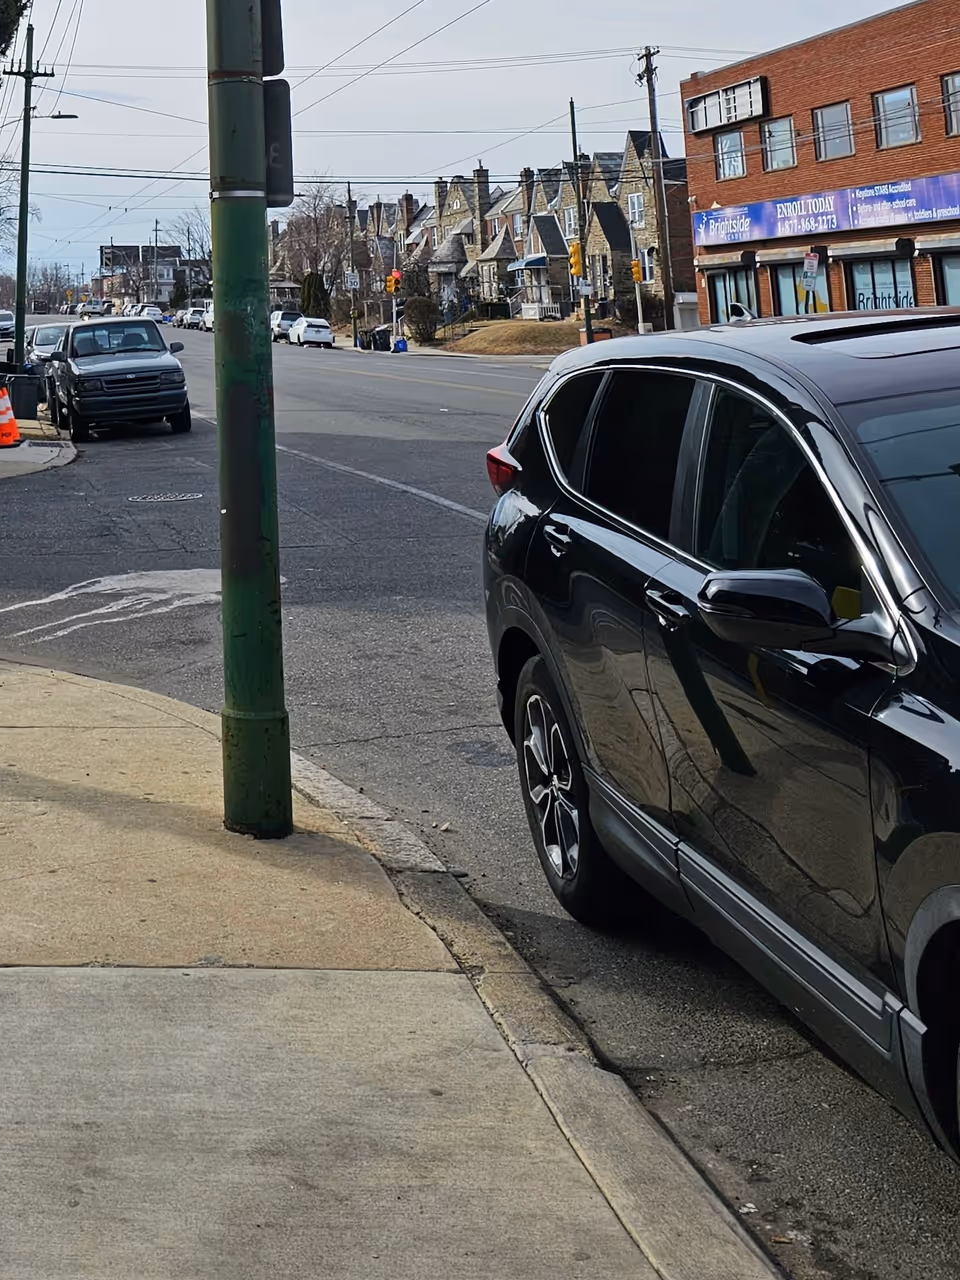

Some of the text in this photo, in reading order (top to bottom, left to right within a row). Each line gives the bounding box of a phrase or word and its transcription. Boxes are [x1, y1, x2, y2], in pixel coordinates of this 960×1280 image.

[776, 196, 835, 218] ENROLL TODAY
[709, 215, 750, 238] Brightside
